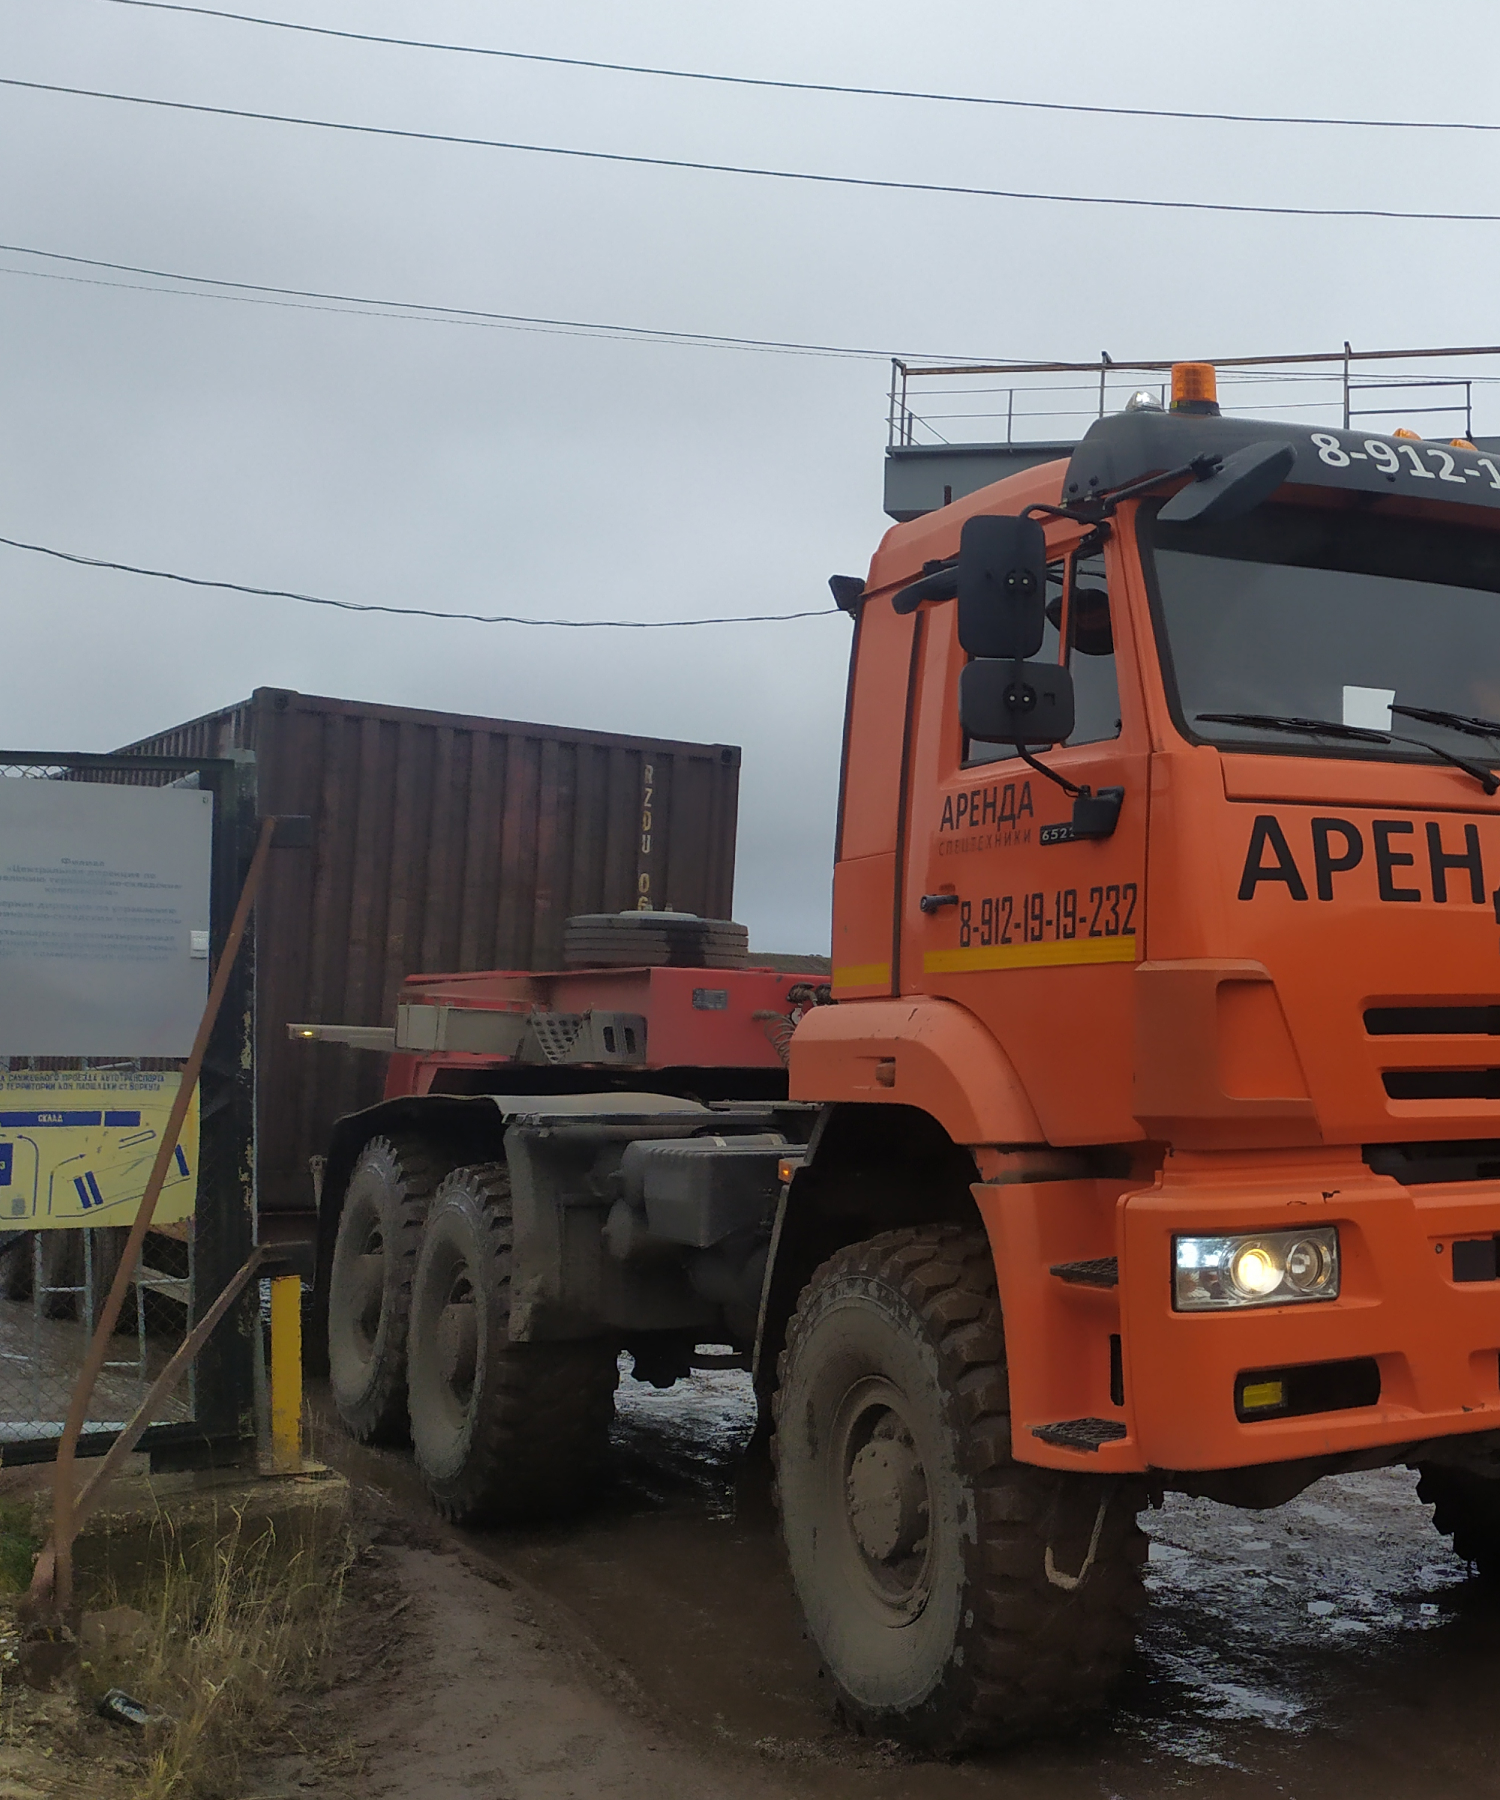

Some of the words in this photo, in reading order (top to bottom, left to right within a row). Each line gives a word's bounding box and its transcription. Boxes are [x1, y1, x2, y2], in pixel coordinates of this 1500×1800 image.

[641, 764, 653, 854] RZDU
[939, 781, 1034, 832] АРЕНДА
[938, 830, 1031, 856] СПЕЦТЕХНИКИ
[959, 883, 1137, 947] 8-912-19-19-232
